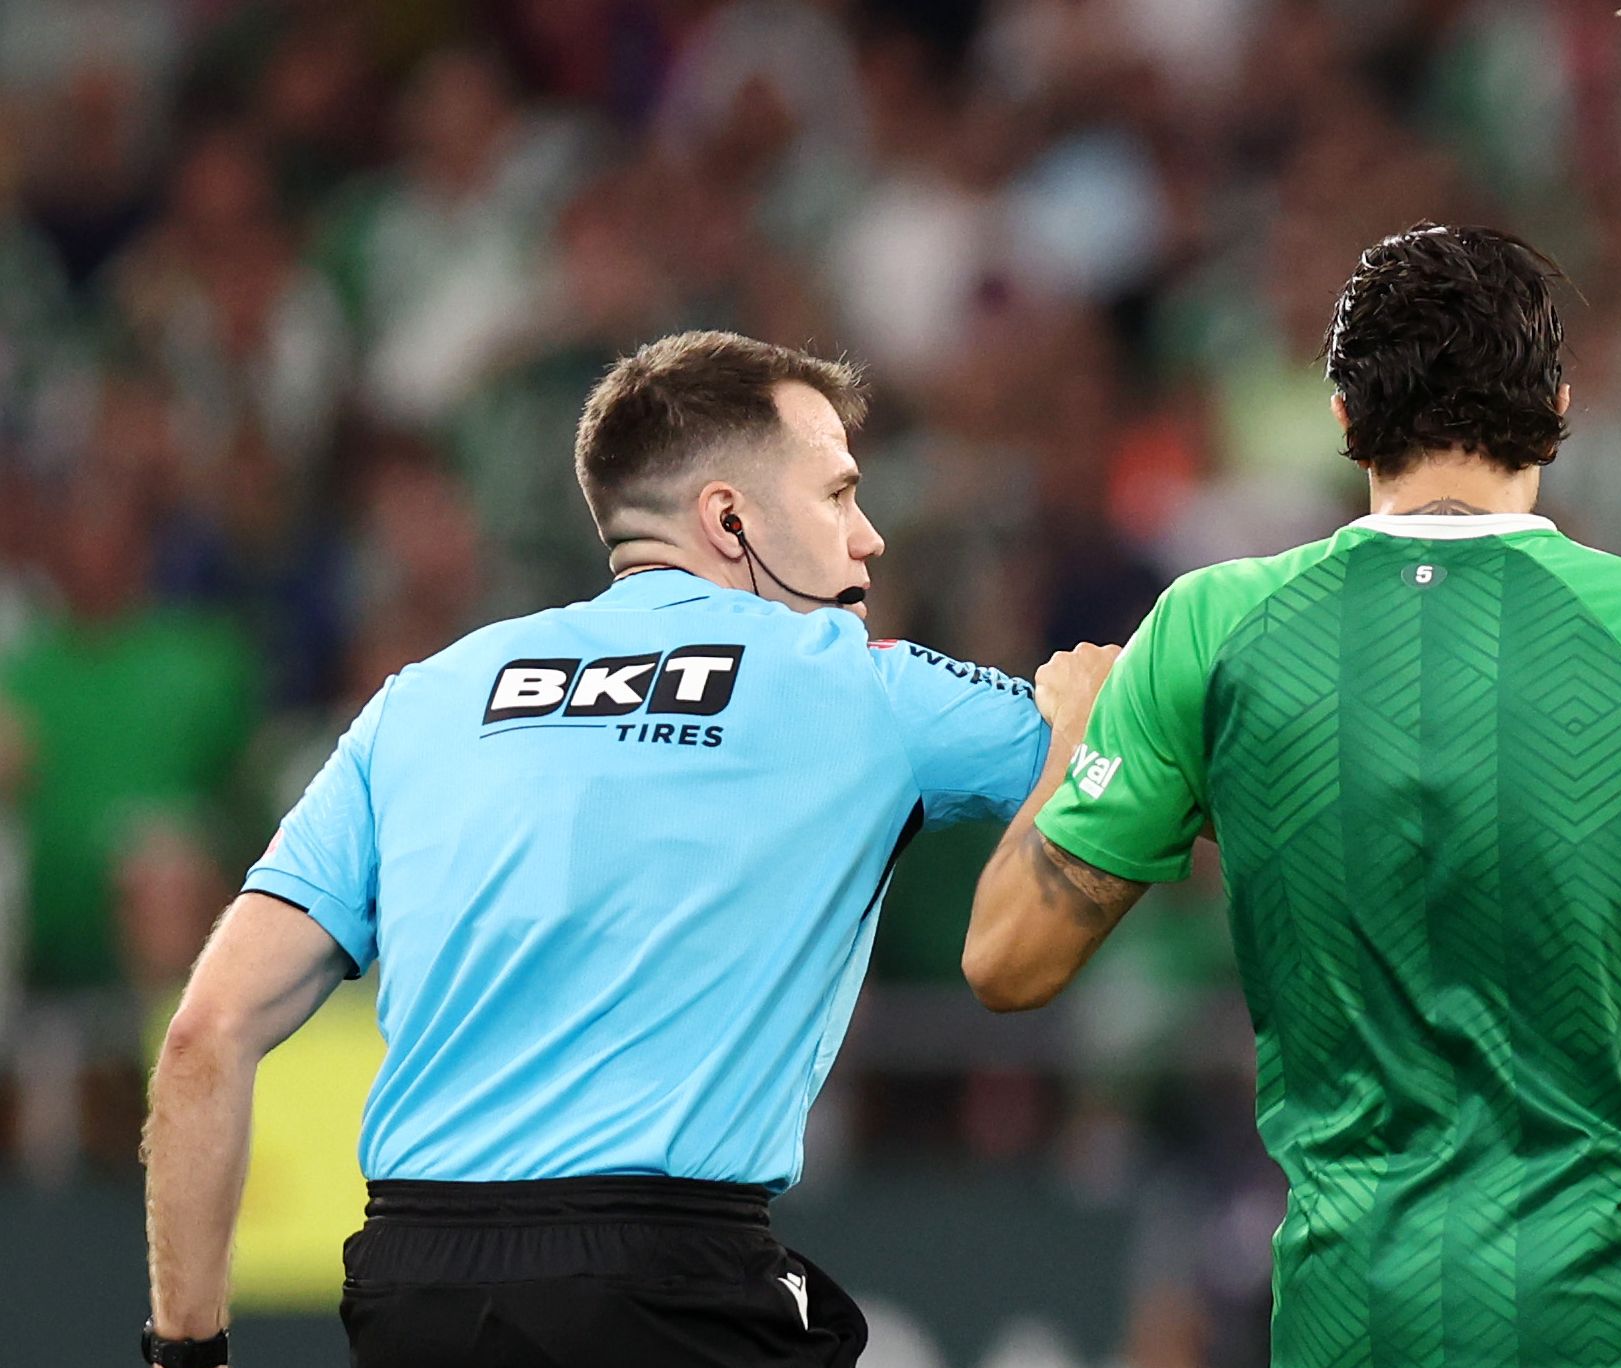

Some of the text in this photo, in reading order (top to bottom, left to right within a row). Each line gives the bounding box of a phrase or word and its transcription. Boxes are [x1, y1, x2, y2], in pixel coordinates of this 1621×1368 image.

[490, 655, 737, 709] BKT
[617, 724, 723, 748] TIRES
[1071, 743, 1122, 789] yal
